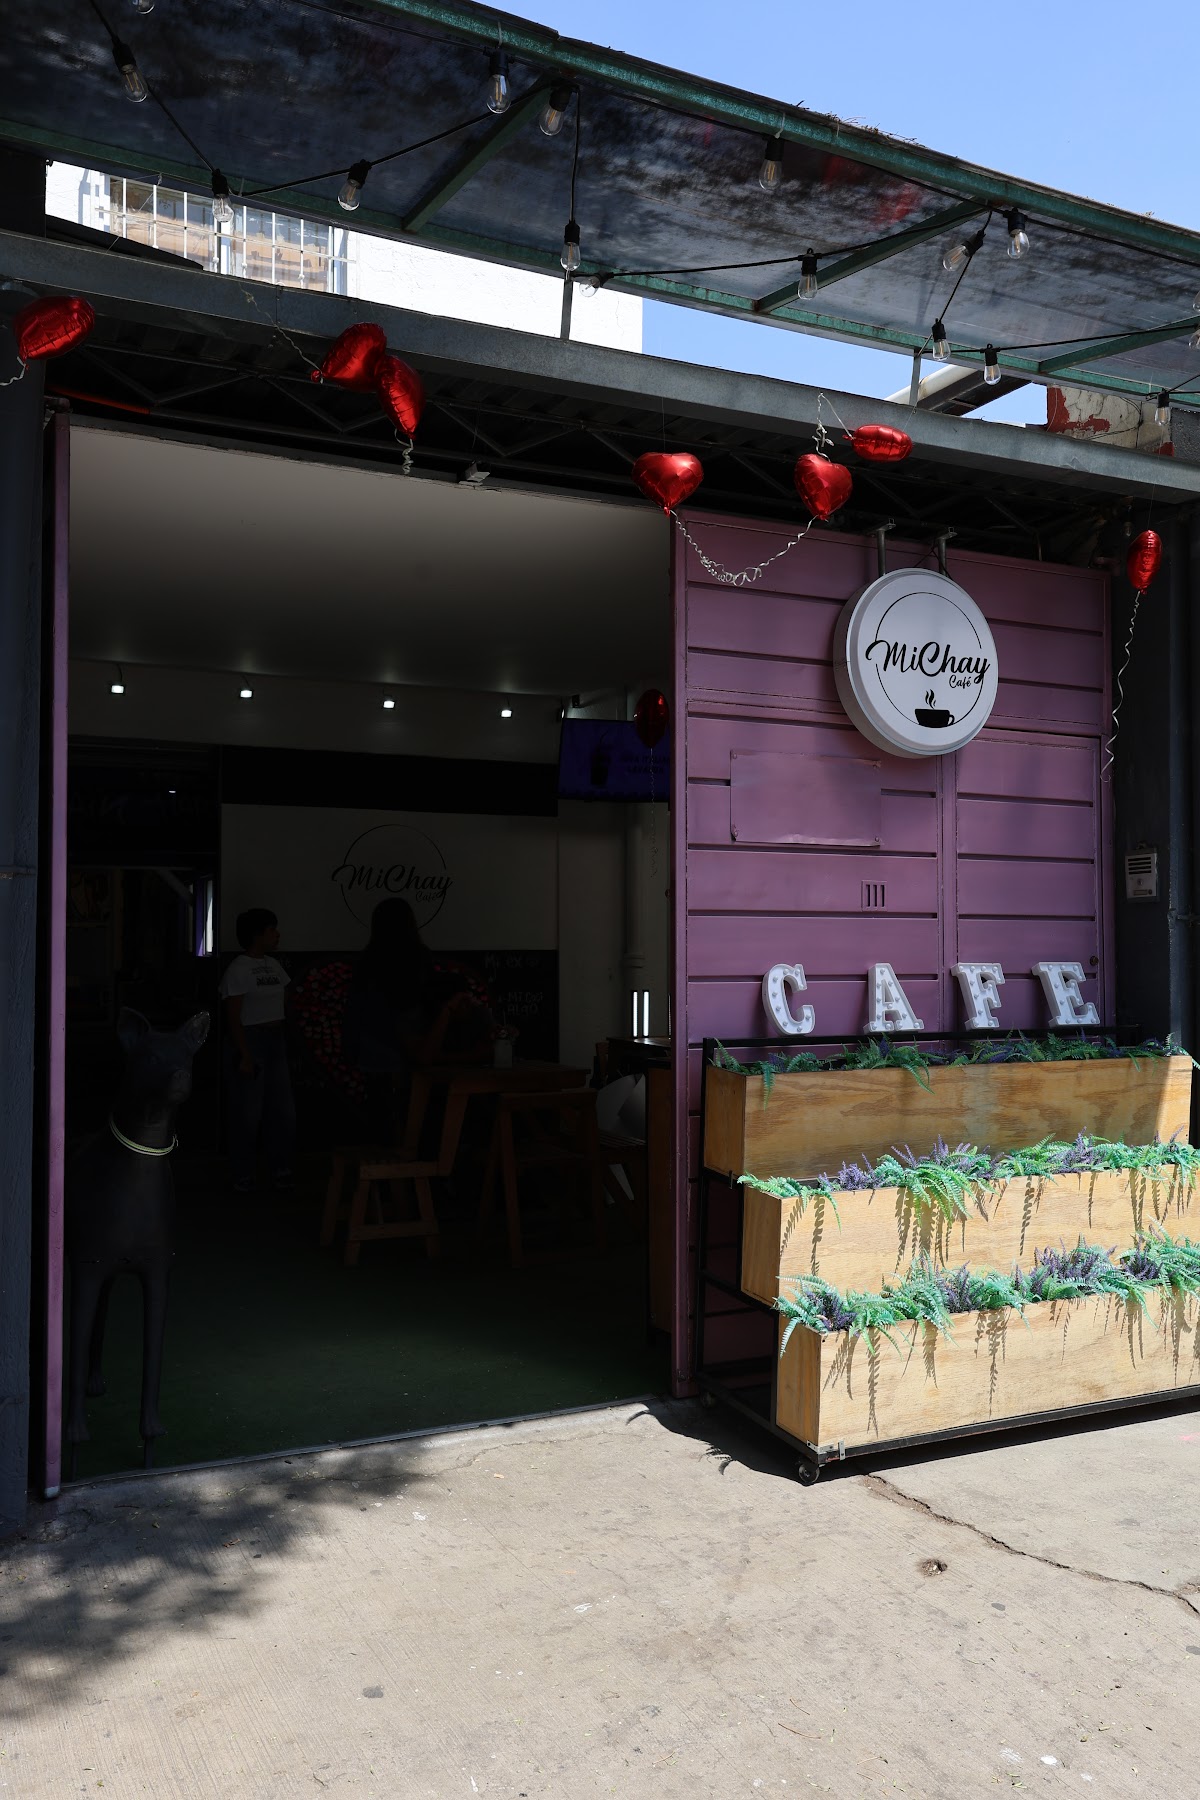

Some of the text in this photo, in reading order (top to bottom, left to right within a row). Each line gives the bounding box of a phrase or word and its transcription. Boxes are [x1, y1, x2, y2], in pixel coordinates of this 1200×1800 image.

[865, 640, 990, 684] MiChay
[949, 674, 972, 689] Café
[331, 864, 453, 898] MiChay
[763, 962, 1100, 1036] CAFE
